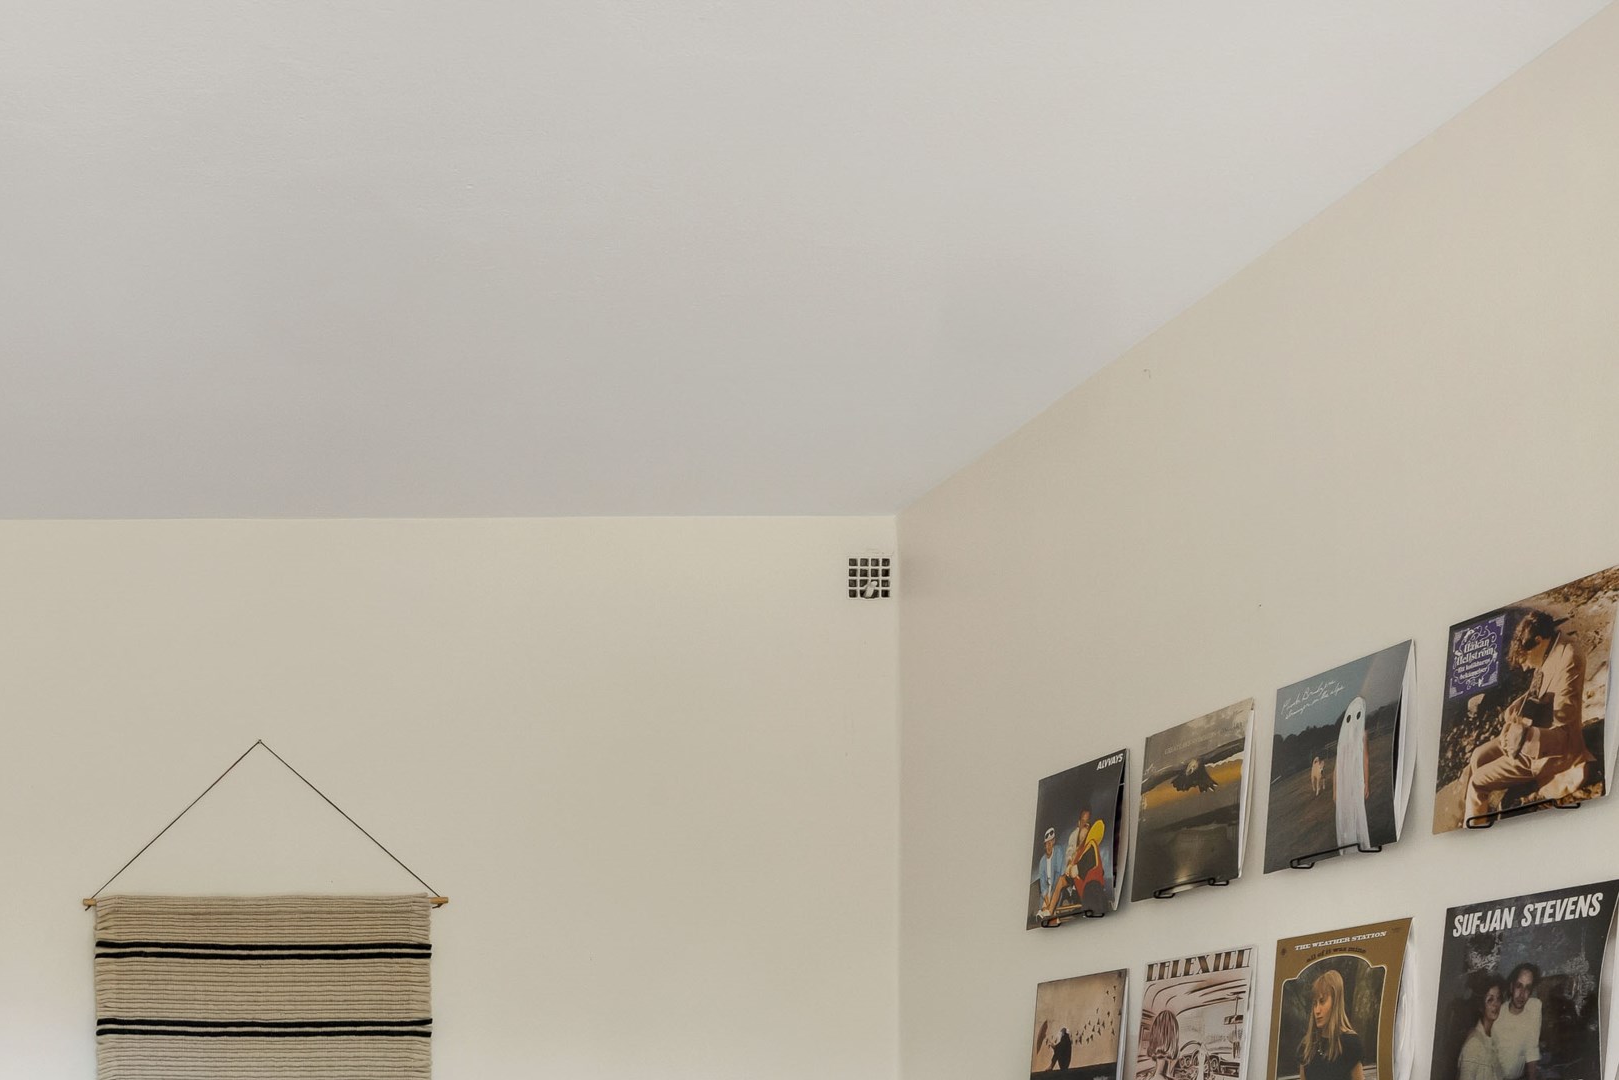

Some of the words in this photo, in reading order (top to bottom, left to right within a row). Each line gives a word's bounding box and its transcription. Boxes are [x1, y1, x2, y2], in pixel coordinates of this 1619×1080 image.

[1096, 753, 1123, 771] ALVVAYS
[1452, 906, 1516, 938] SUFJAN
[1521, 892, 1604, 927] STEVENS
[1294, 943, 1311, 951] THE
[1311, 937, 1351, 948] WEATHER
[1351, 930, 1388, 942] STATION
